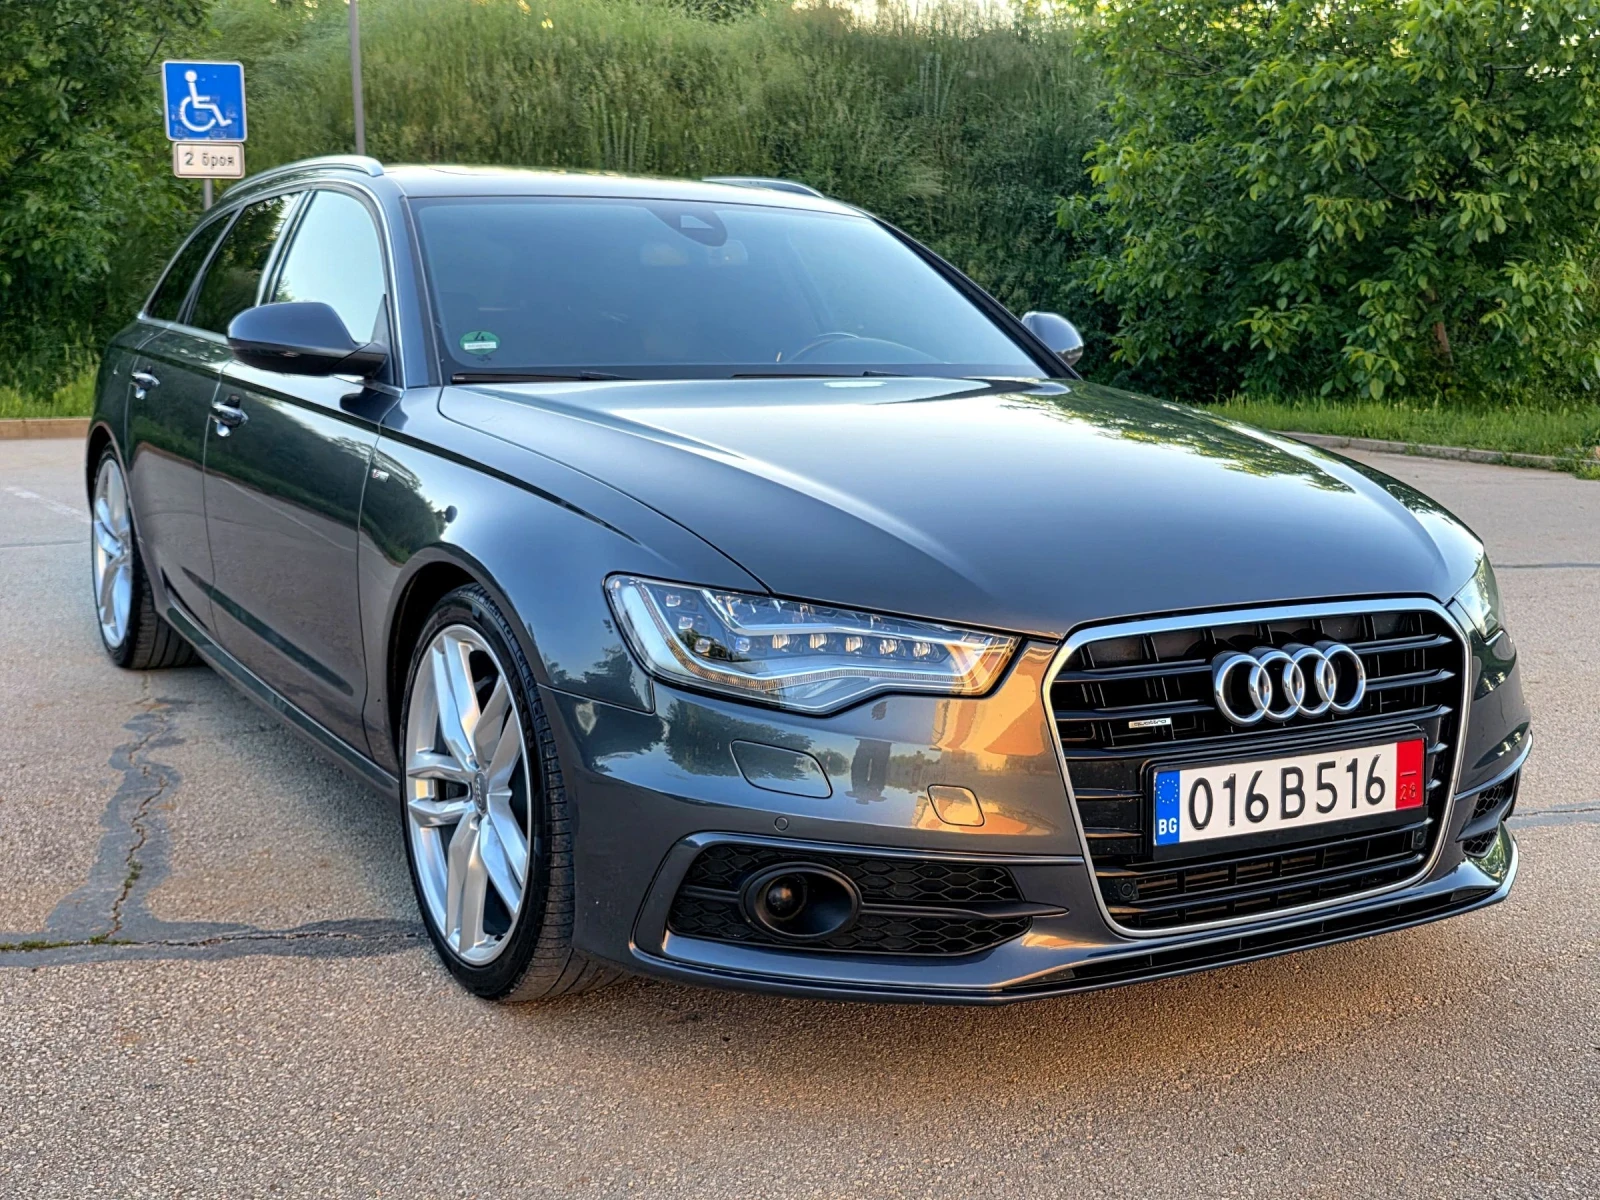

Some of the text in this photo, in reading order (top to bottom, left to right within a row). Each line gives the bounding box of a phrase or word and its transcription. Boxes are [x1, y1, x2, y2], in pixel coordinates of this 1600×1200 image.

[184, 152, 235, 169] 2 броя
[1133, 719, 1167, 727] quattro
[1188, 753, 1386, 830] 016B516
[1158, 817, 1177, 835] BG
